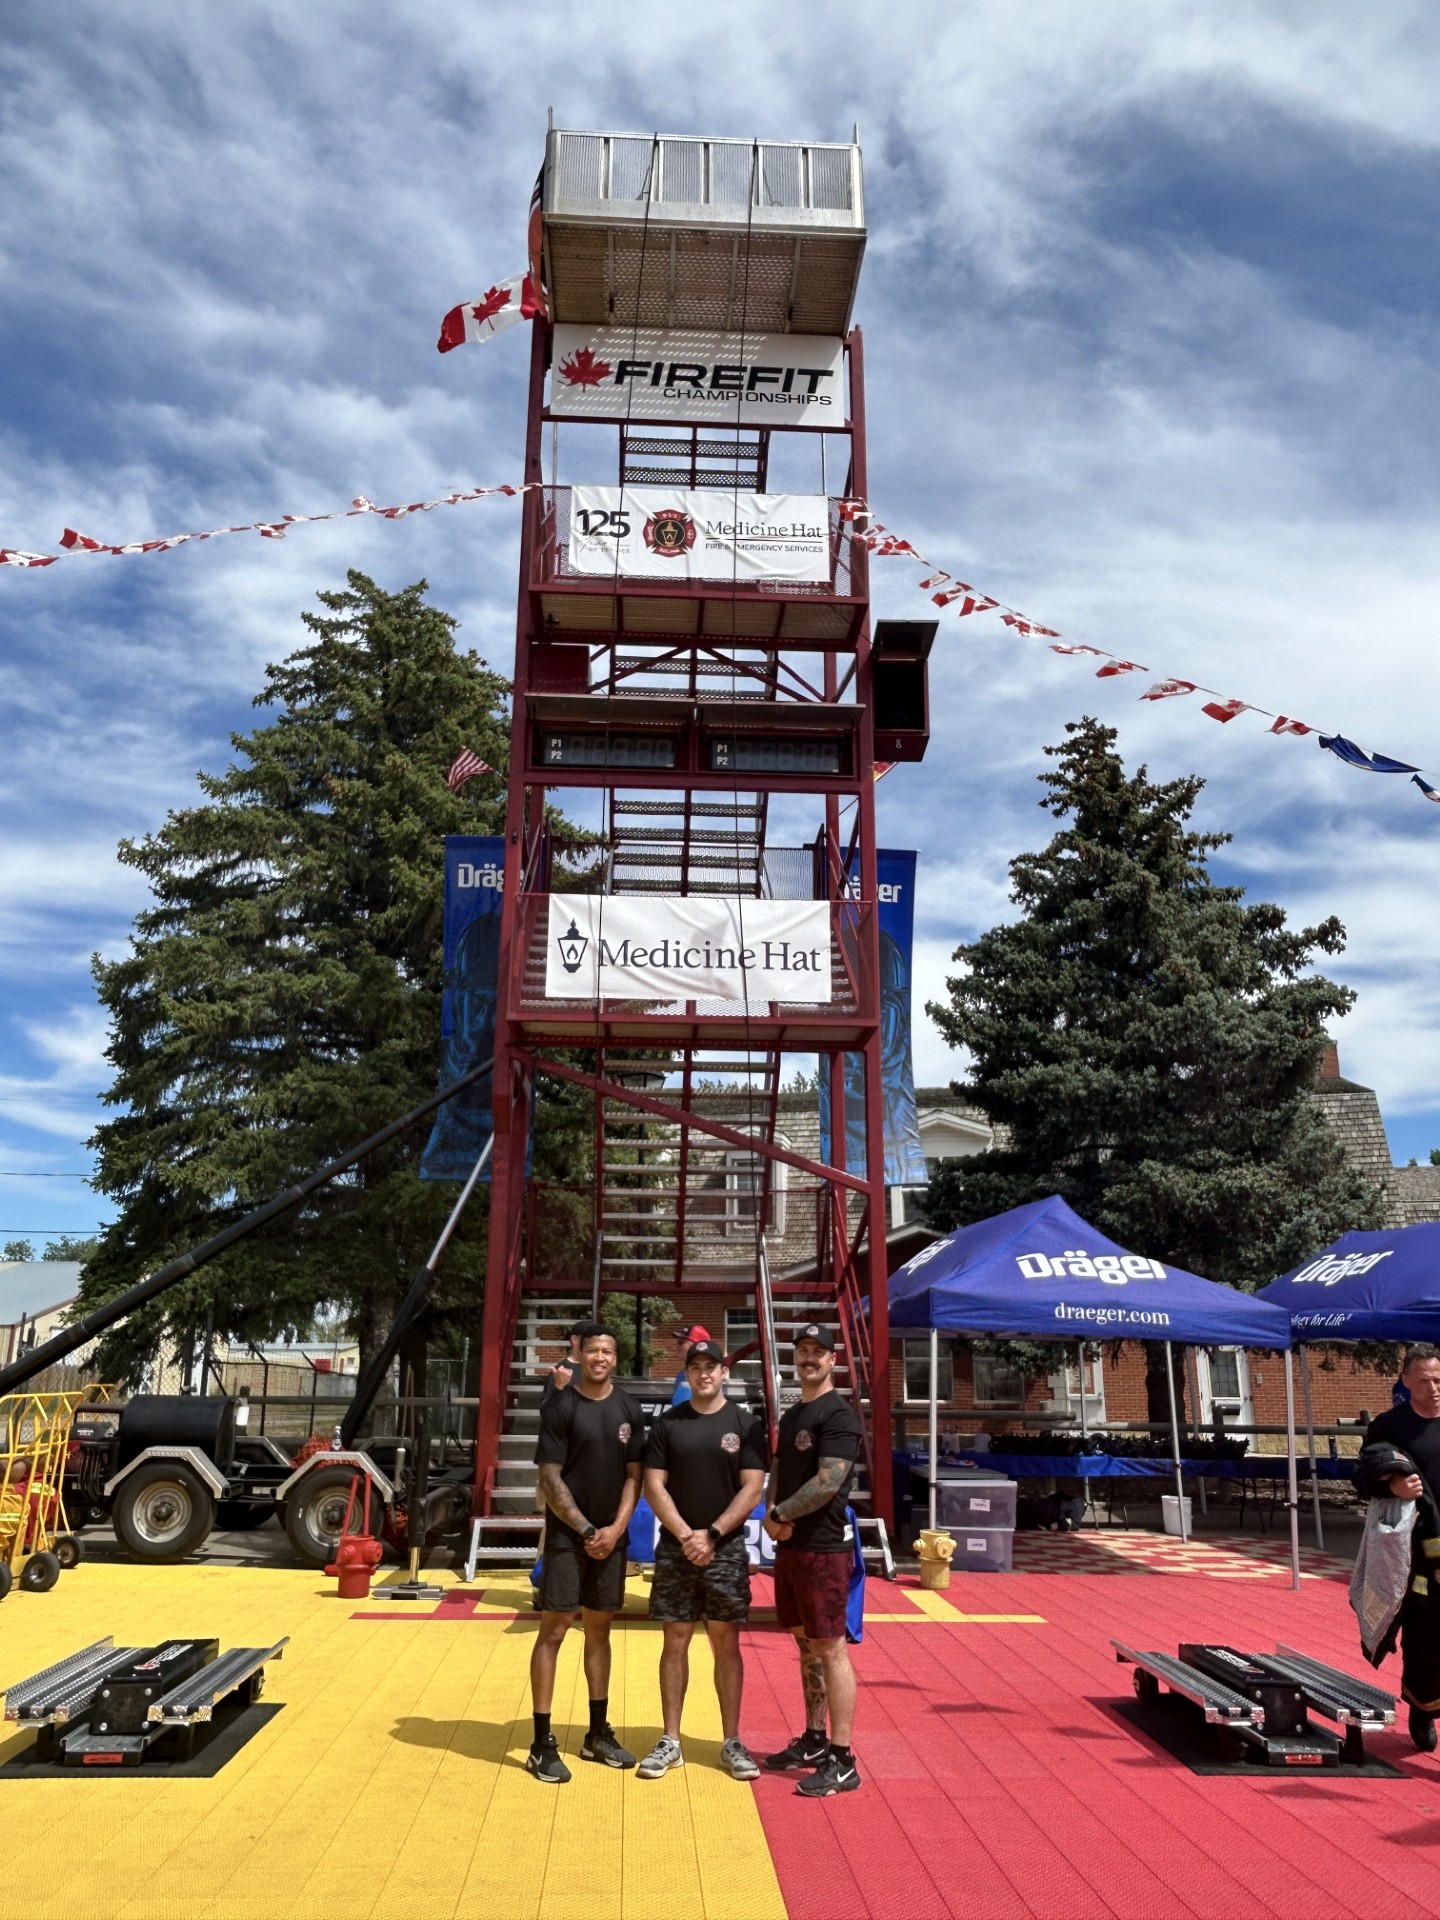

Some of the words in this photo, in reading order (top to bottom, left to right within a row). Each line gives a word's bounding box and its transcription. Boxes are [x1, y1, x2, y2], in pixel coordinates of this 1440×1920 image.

[614, 360, 834, 394] FIREFIT
[663, 388, 832, 406] CHAMPIONSHIPS
[576, 508, 631, 538] 125
[705, 520, 788, 537] Medicine
[791, 523, 824, 538] Hat
[733, 544, 783, 552] MERGENCY
[785, 545, 823, 553] SERVICES
[551, 738, 562, 748] P1
[717, 744, 728, 753] P1
[551, 750, 562, 760] P2
[716, 756, 728, 766] P2
[598, 938, 756, 969] Medicine
[761, 941, 822, 972] Hat
[1015, 1250, 1167, 1285] Dräger
[1291, 1250, 1395, 1287] Dräger
[1054, 1302, 1170, 1325] draeger.com
